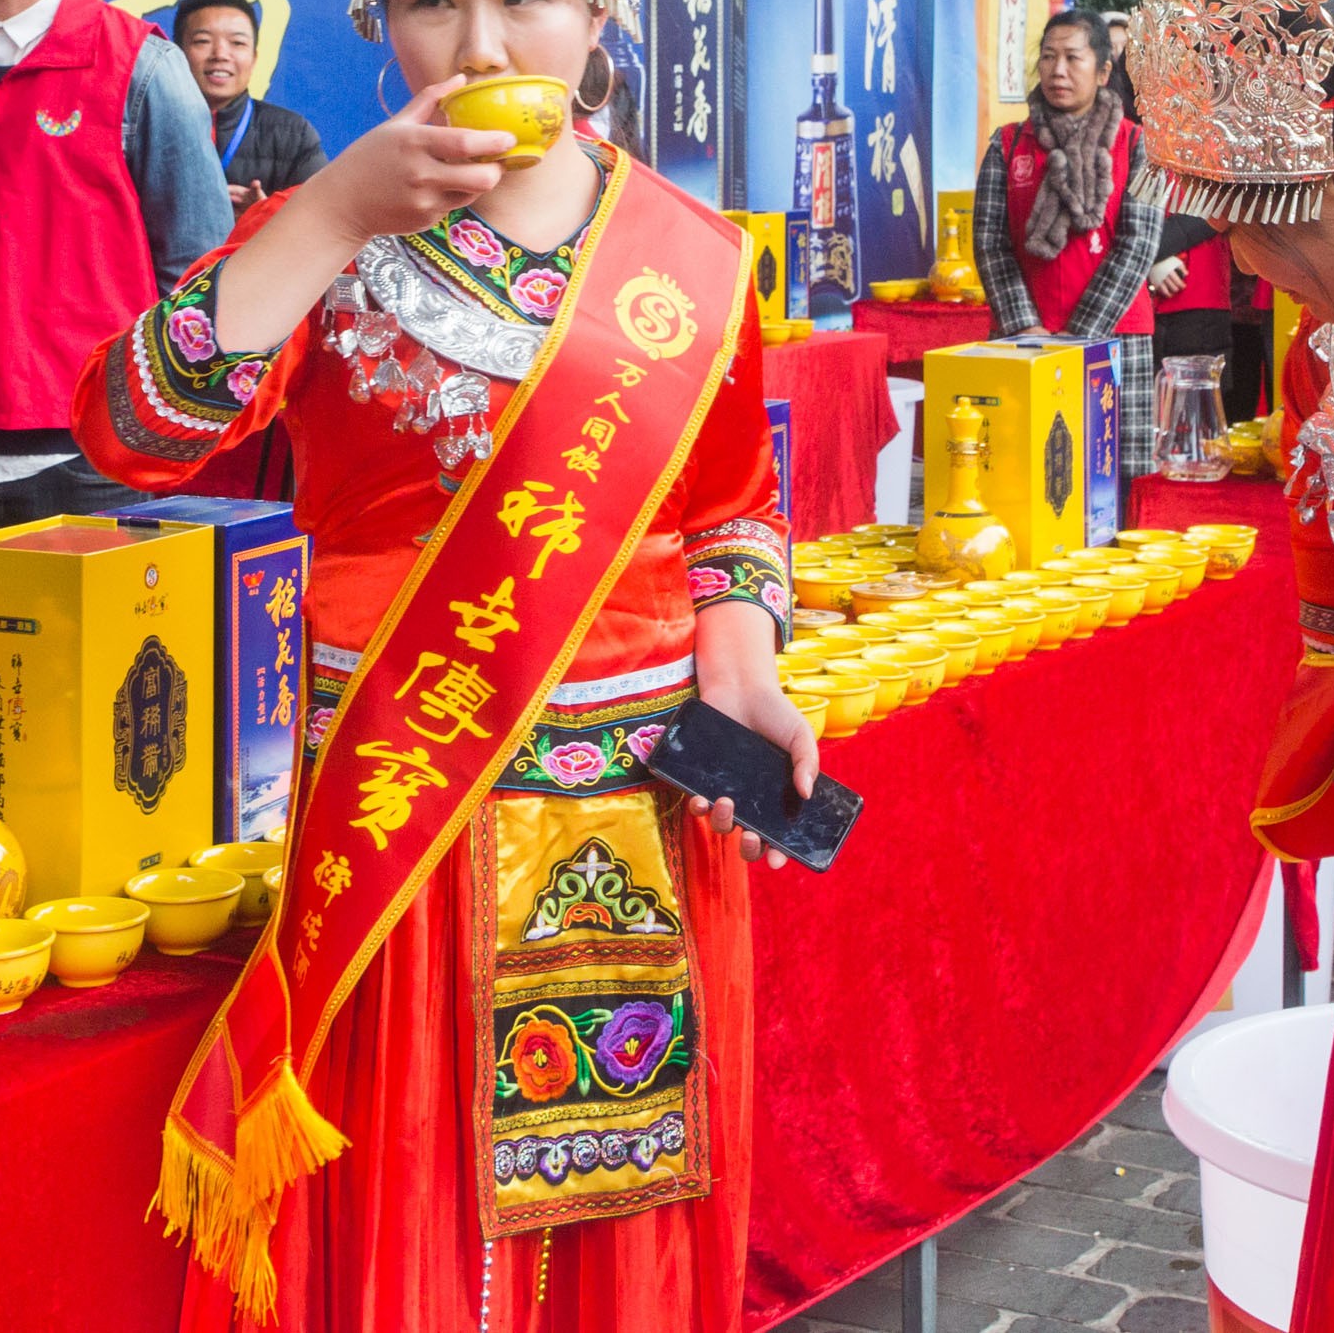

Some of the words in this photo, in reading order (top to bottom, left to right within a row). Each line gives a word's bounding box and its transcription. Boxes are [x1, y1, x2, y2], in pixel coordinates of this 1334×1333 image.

[560, 358, 647, 484] 万人同饮
[266, 577, 297, 727] 稻花香
